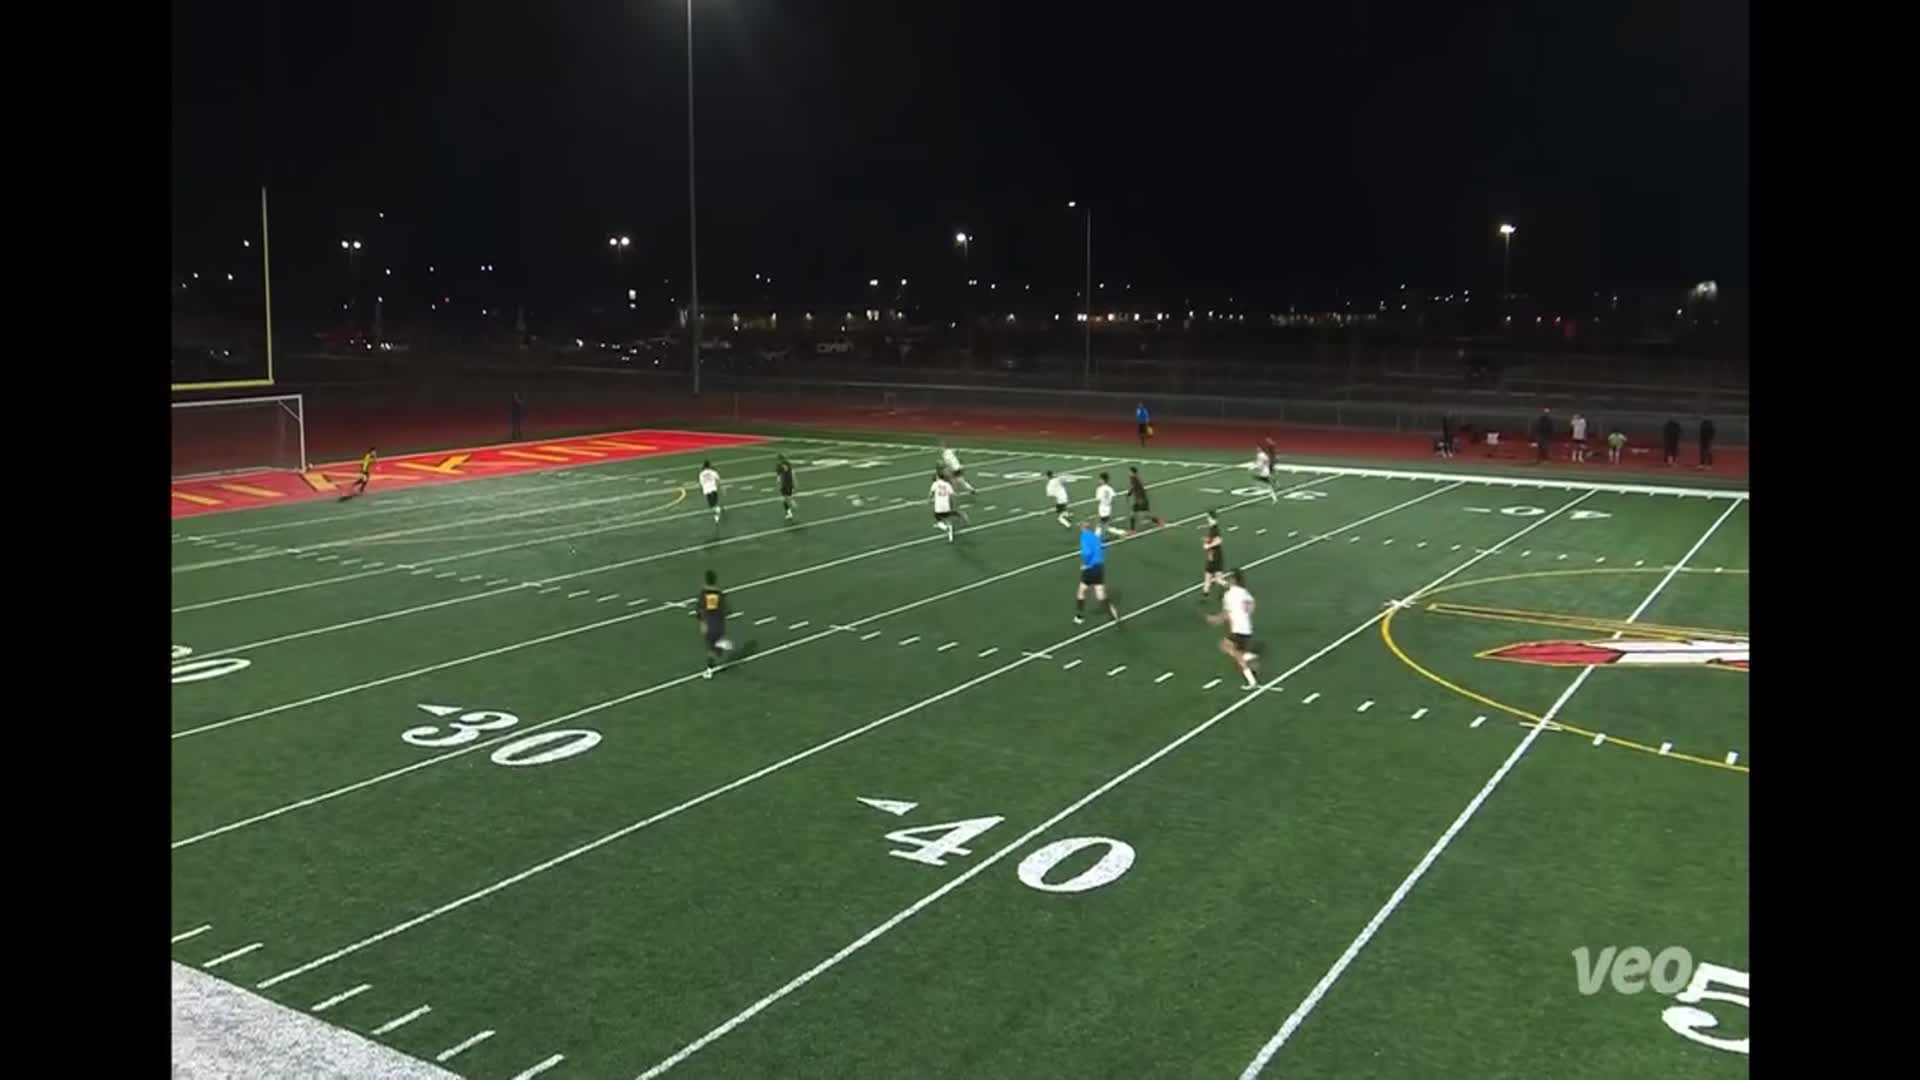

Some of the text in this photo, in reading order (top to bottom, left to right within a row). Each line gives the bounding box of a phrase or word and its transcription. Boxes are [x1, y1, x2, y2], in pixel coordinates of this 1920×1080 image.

[1501, 505, 1613, 520] 40
[401, 710, 602, 767] 30
[884, 815, 1136, 893] 40
